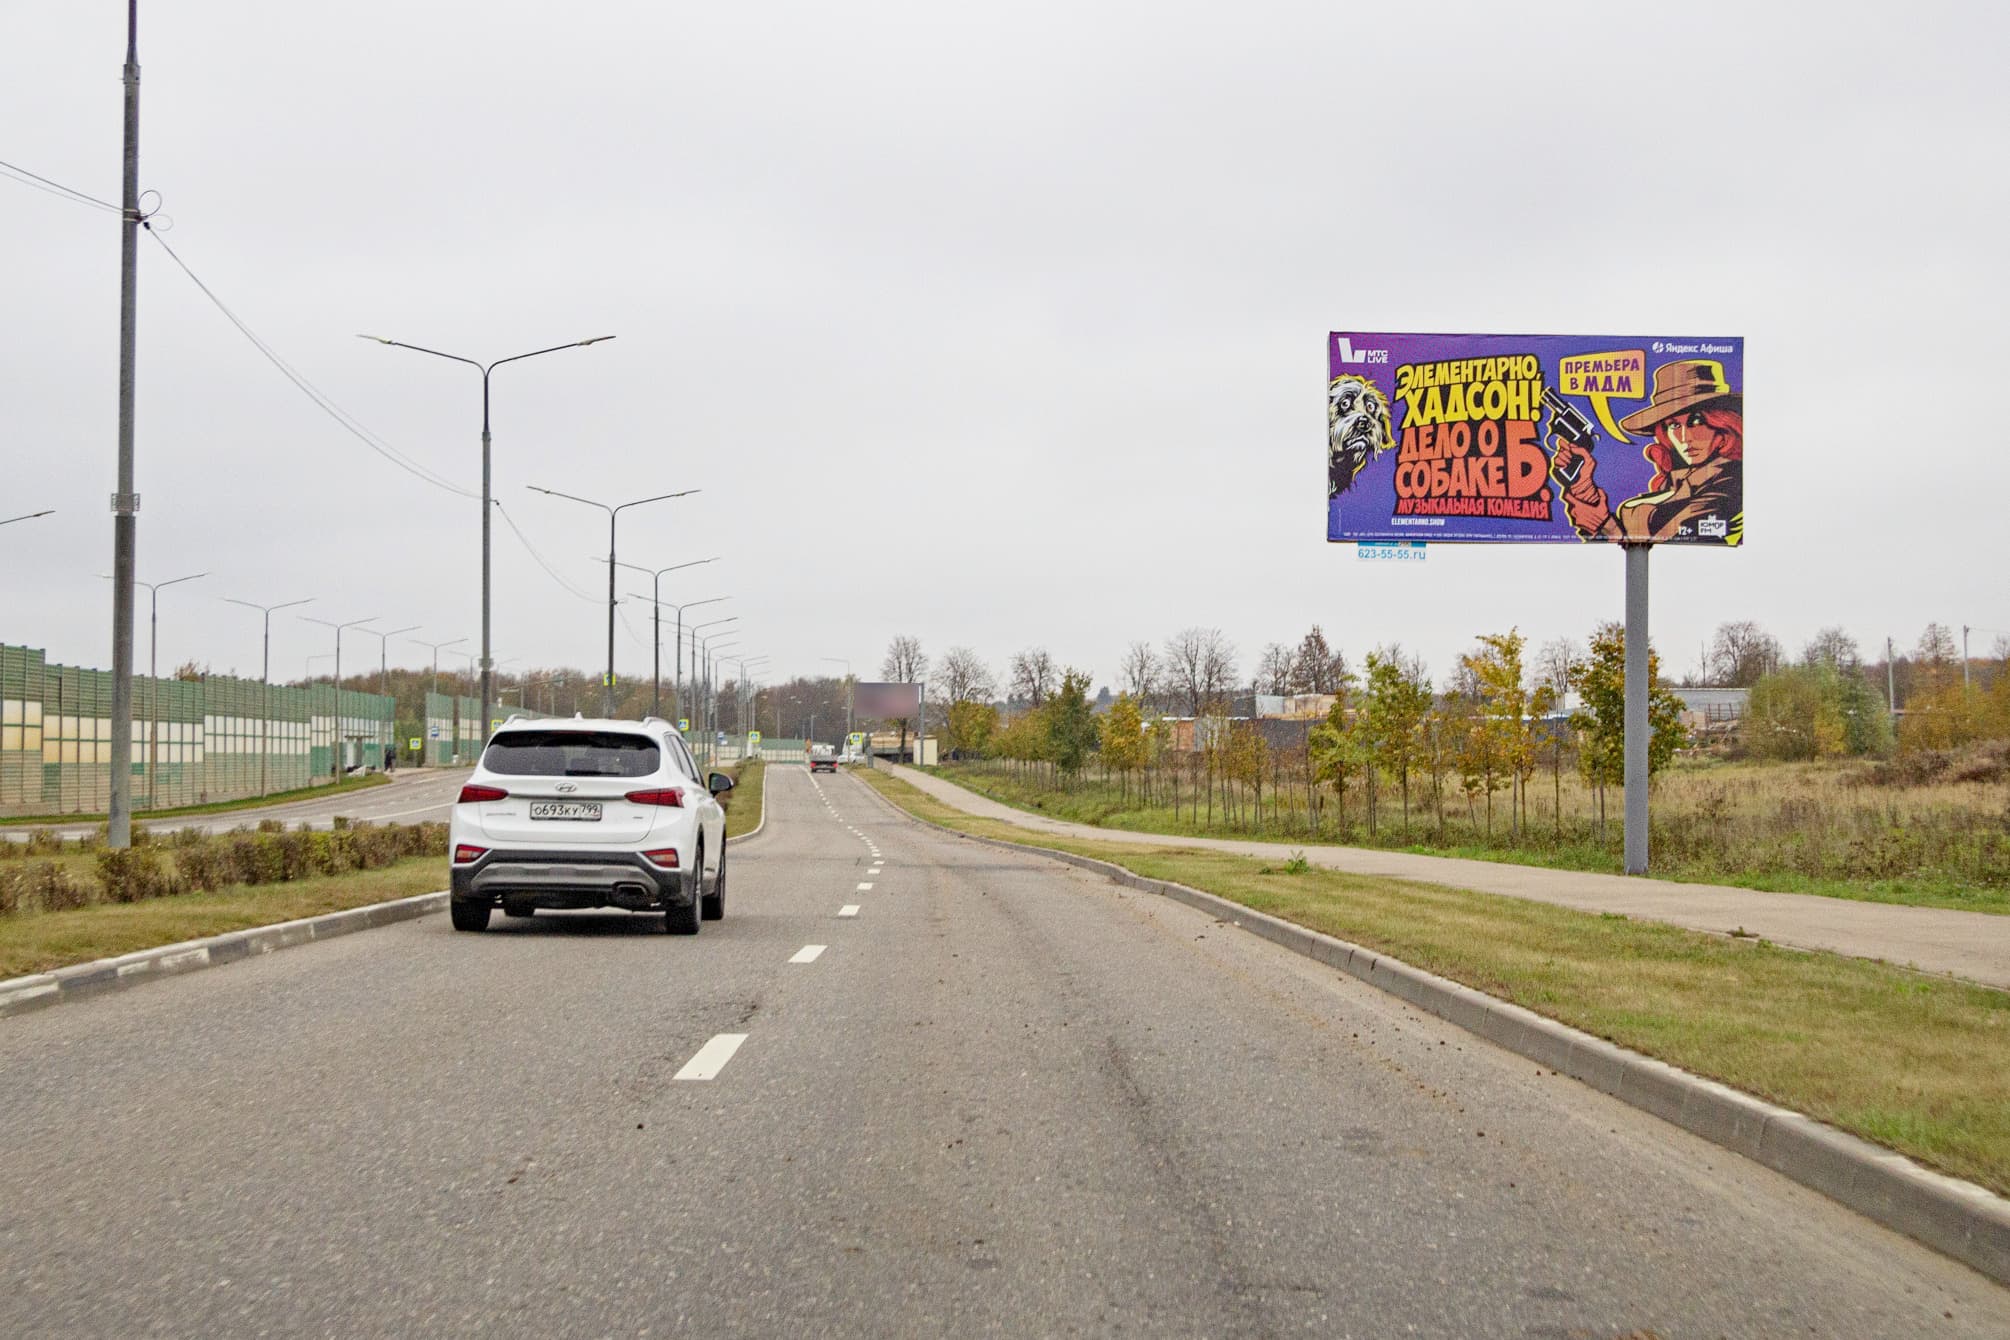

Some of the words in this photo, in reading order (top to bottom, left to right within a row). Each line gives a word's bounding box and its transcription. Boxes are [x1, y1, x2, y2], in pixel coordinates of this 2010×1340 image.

[1665, 343, 1698, 354] Яндекс
[1699, 343, 1733, 355] Афиша
[1565, 358, 1640, 374] ПРЕМЬЕРА
[1395, 355, 1542, 400] ЭЛЕМЕНТАРНО,
[1570, 378, 1579, 390] В
[1583, 375, 1632, 392] МДМ
[1401, 380, 1542, 429] ХАДСОН!
[1399, 422, 1471, 462] ДЕЛО
[1477, 420, 1499, 457] О
[1395, 457, 1506, 498] СОБАКЕ
[1505, 420, 1550, 501] Б.
[1397, 498, 1484, 515] МУЗЫКАЛЬНАЯ
[1487, 499, 1549, 518] КОМЕДИЯ
[1678, 526, 1693, 535] 12+
[1358, 548, 1426, 560] 623-55-55.ru
